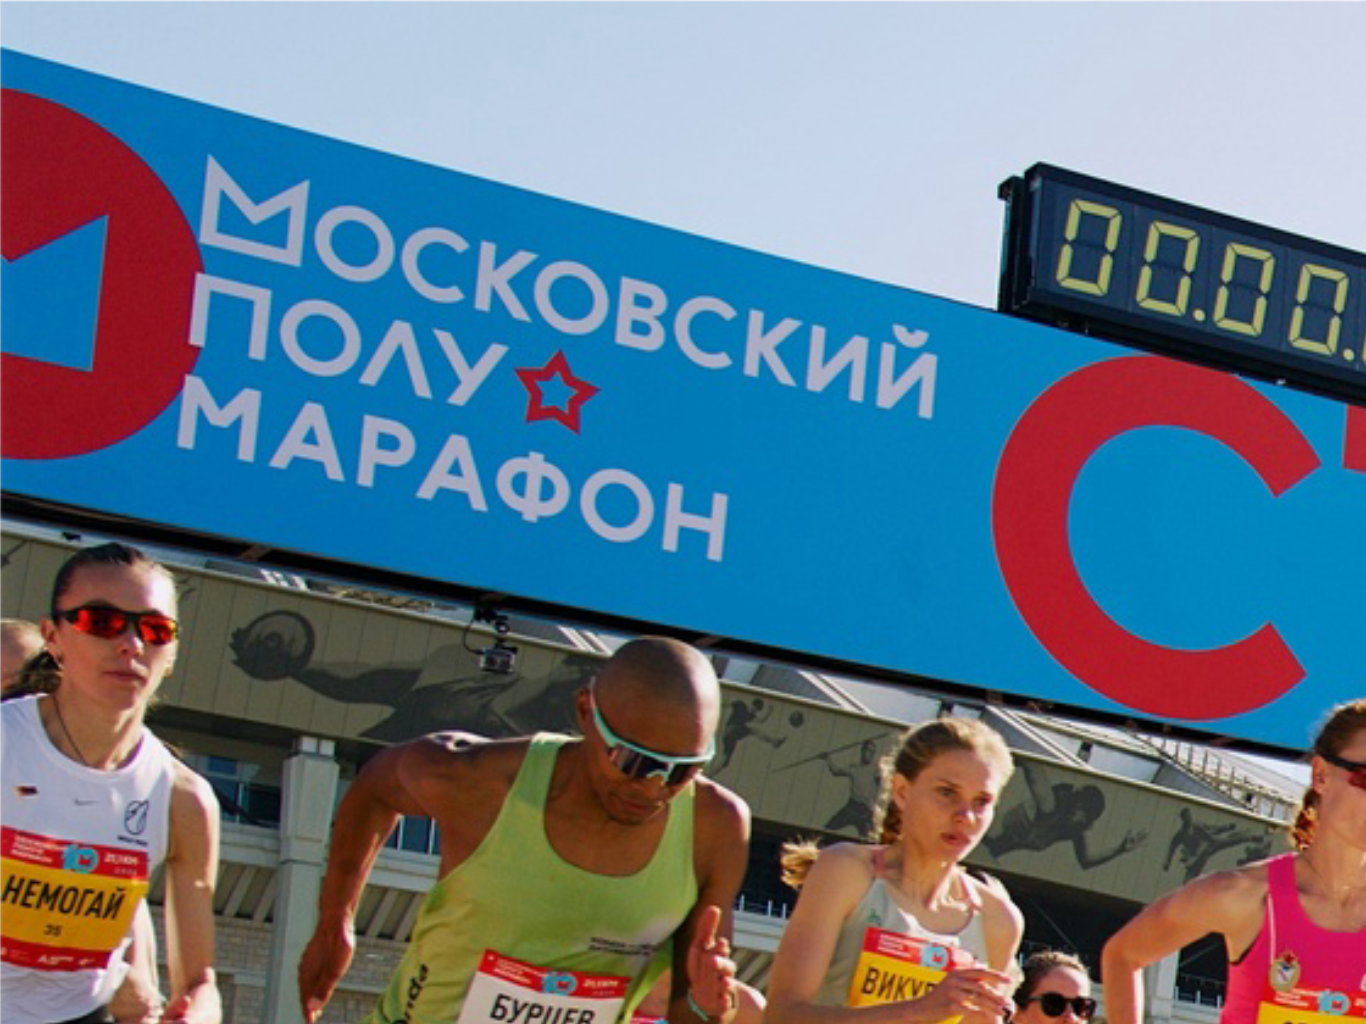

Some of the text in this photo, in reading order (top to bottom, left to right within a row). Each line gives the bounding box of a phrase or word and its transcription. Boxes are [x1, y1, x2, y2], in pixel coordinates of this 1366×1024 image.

[188, 271, 508, 406] ПОЛУ
[199, 154, 938, 419] МОСКОВСКИЙ
[176, 373, 729, 563] МАРАФОН
[1, 873, 128, 920] НЕМОГАЙ
